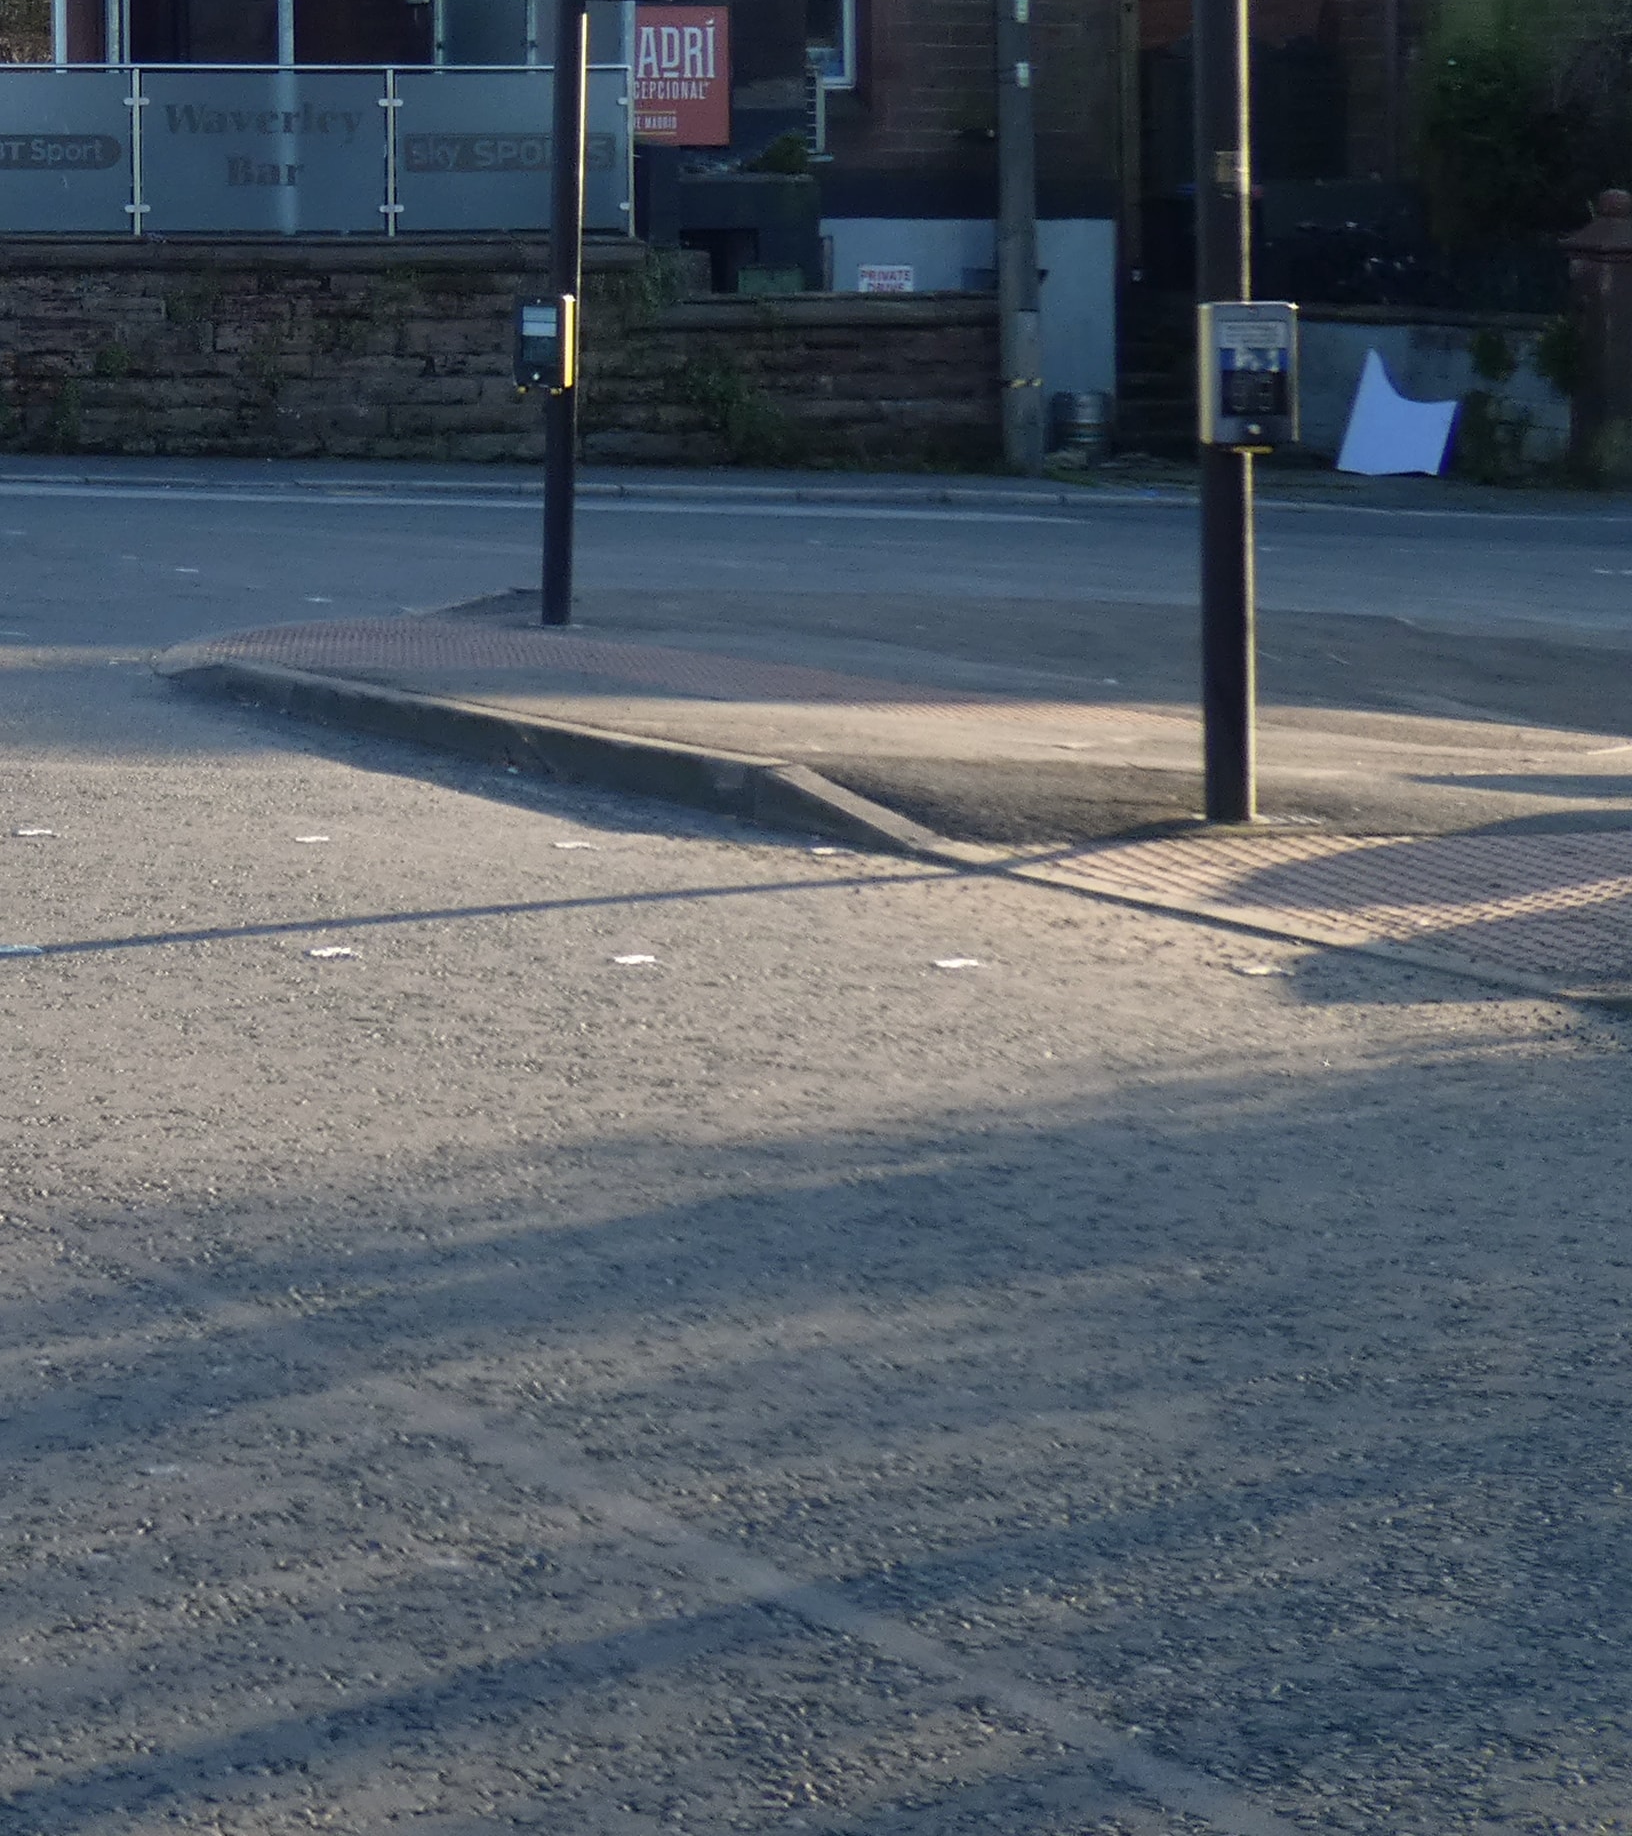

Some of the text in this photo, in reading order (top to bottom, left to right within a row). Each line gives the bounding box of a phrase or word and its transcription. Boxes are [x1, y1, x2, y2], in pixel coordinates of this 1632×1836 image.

[637, 18, 716, 79] ADRÍ
[634, 82, 707, 100] CEPCIONAL
[165, 103, 363, 143] Waverley
[31, 138, 104, 168] Sport
[411, 137, 609, 168] sky SPOS
[226, 154, 305, 186] Bar
[861, 270, 910, 281] PRIVATE
